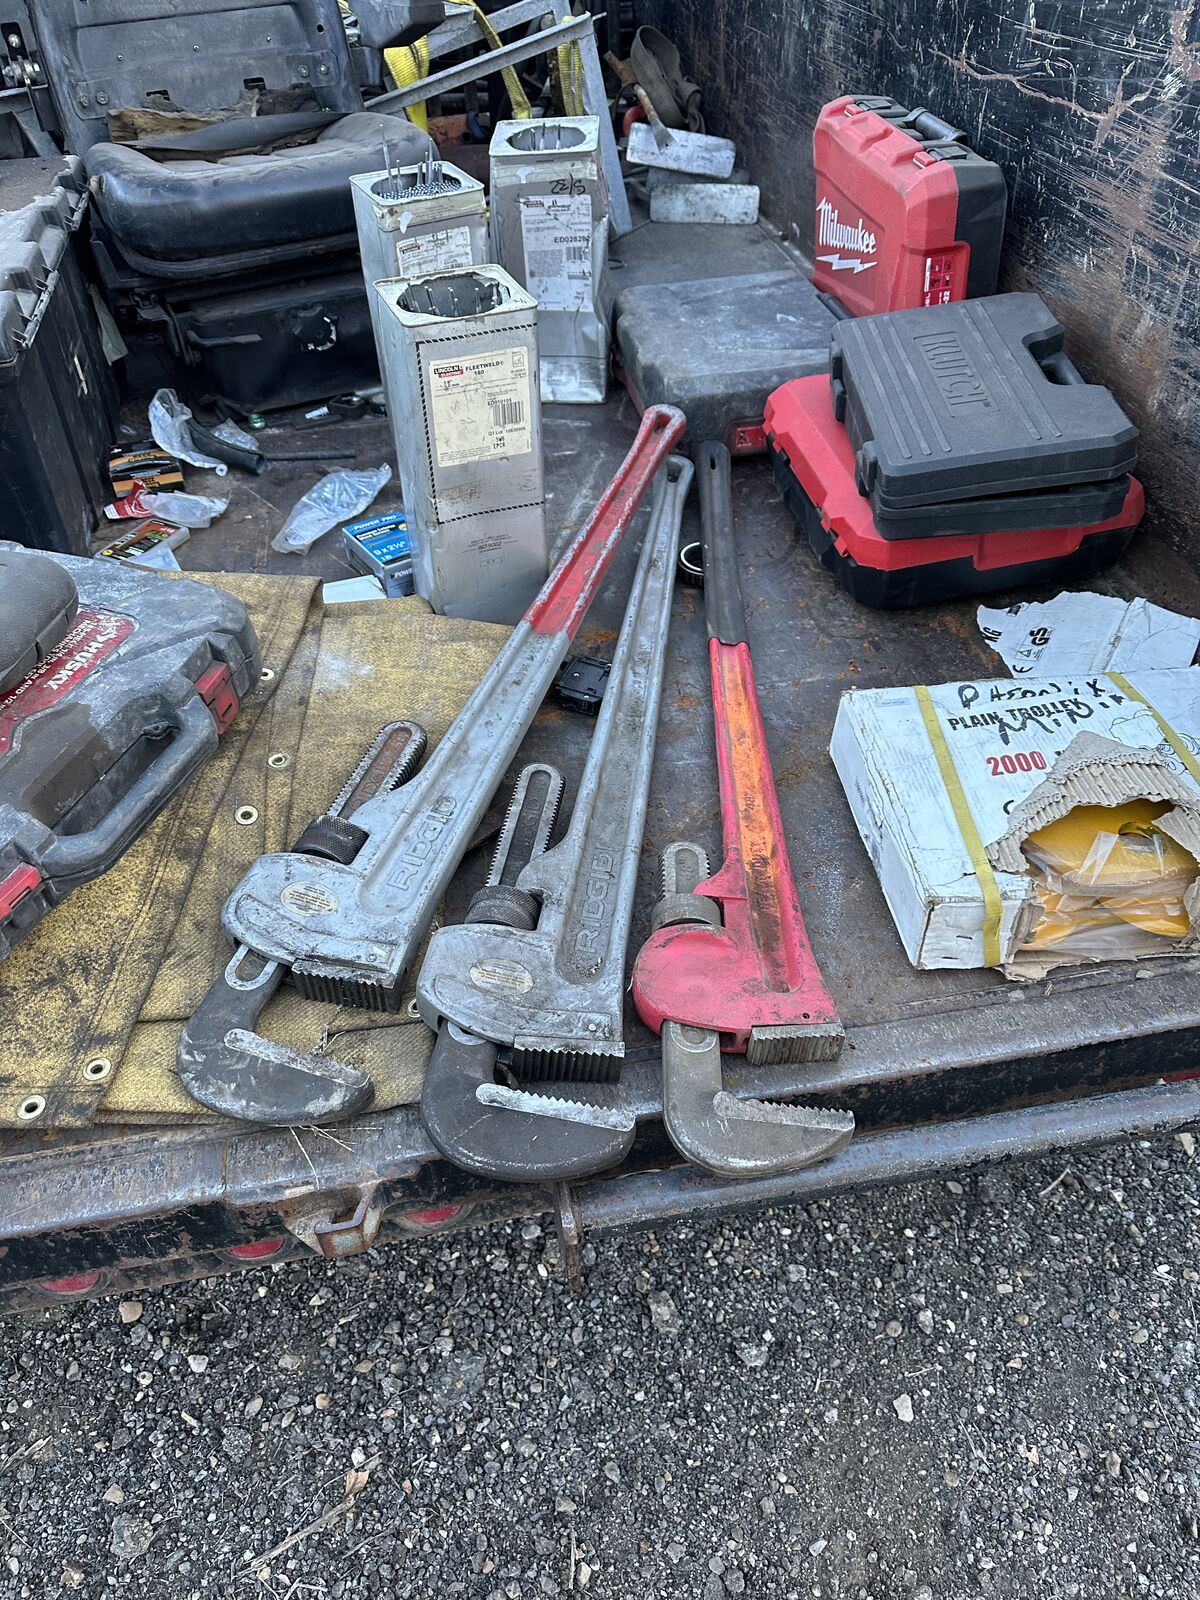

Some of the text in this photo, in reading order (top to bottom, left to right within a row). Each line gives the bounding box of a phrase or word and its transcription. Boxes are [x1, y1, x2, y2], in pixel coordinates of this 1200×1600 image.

[816, 197, 877, 254] Milwaukee
[434, 365, 460, 374] LINCOLN
[921, 338, 988, 406] KLUTCH
[353, 519, 380, 531] POWER
[1029, 627, 1051, 646] GS
[46, 640, 105, 691] HUSKY
[15, 678, 33, 696] AND
[947, 710, 1001, 731] PLAIN
[986, 750, 1047, 776] 2000
[387, 795, 456, 891] RIDGID
[574, 852, 613, 953] RIDGID
